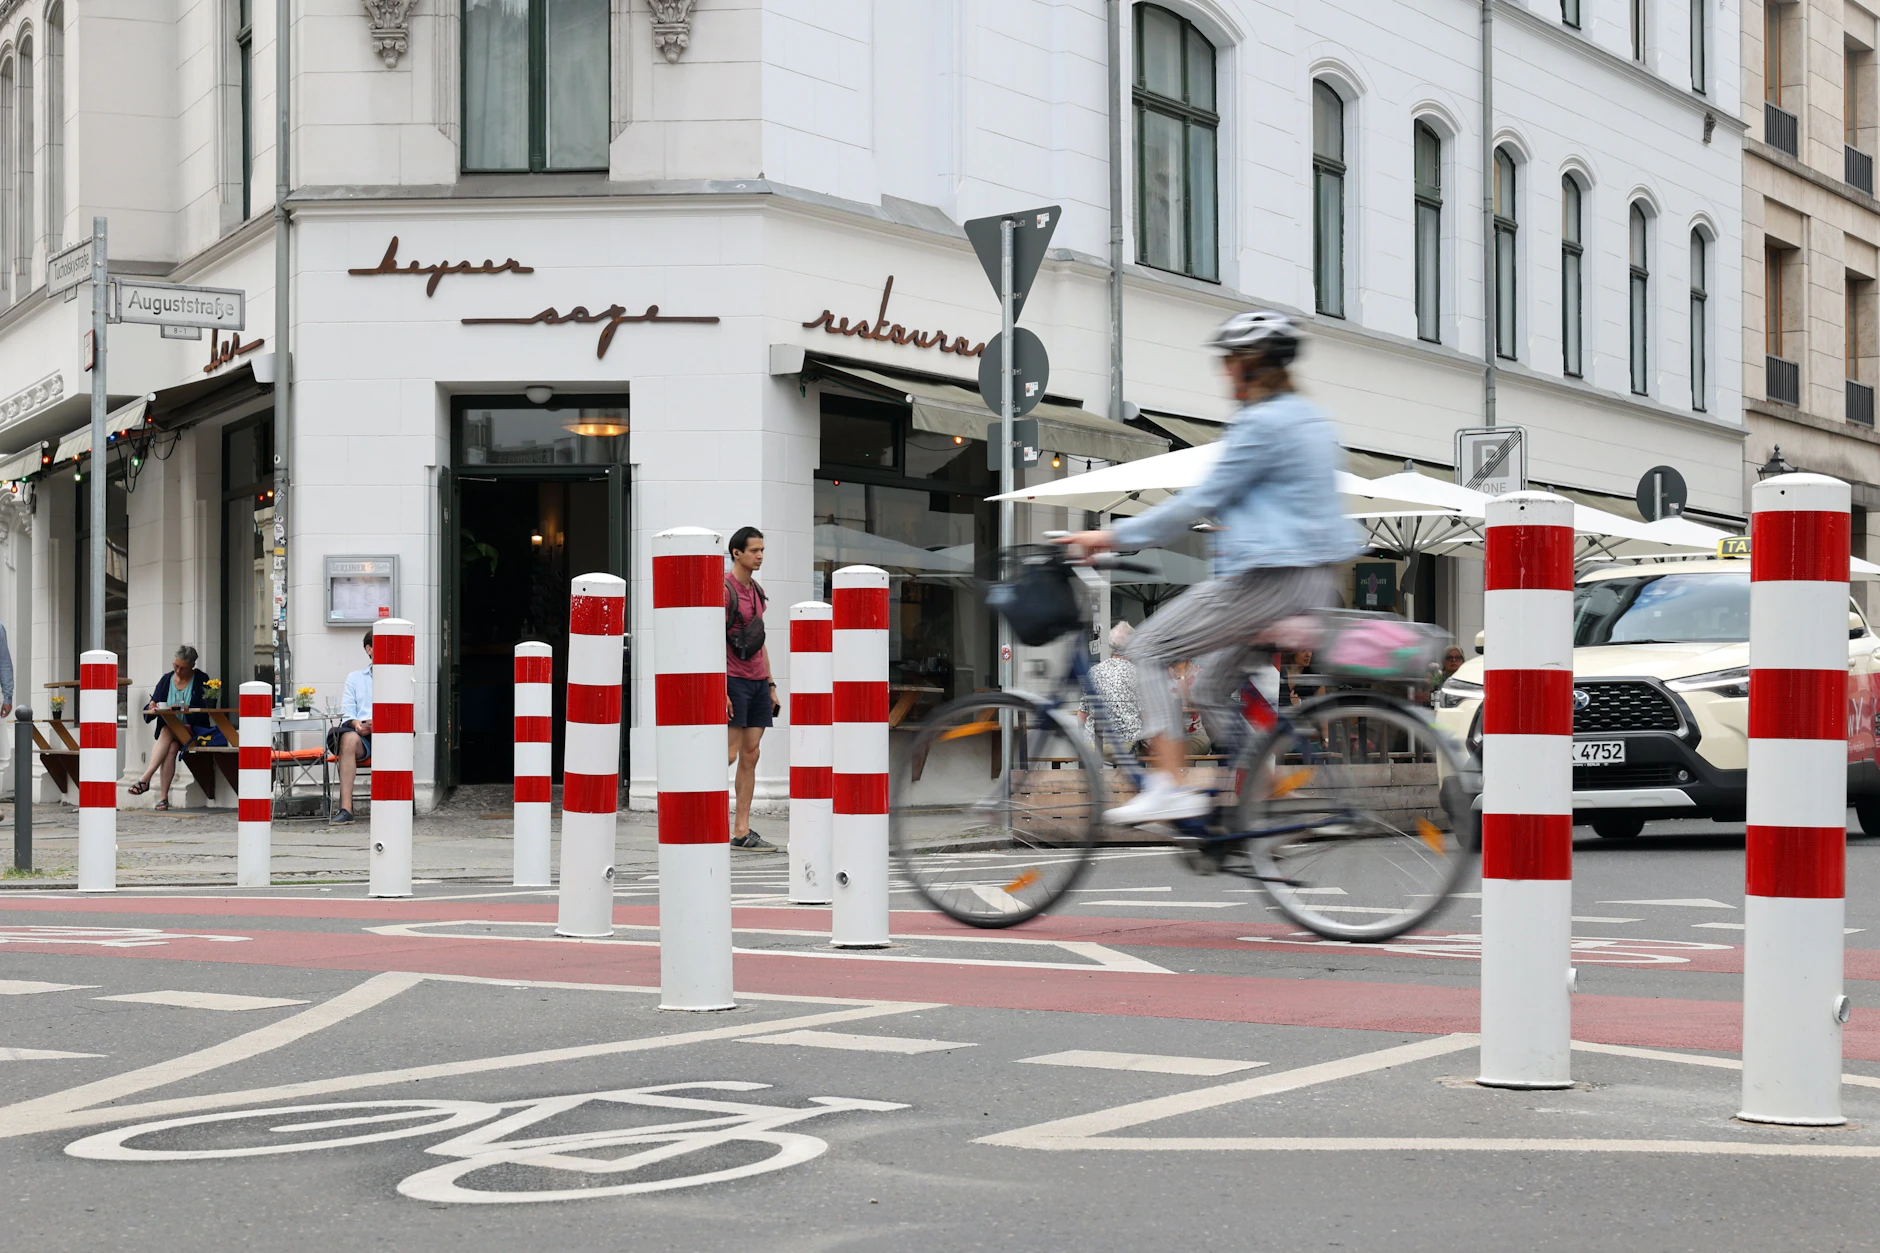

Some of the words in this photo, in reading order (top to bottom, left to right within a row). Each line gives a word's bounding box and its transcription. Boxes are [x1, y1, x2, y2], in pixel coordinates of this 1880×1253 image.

[54, 248, 90, 281] Tucholskystraße
[347, 235, 535, 298] keyser
[128, 290, 235, 320] Auguststraße
[1727, 541, 1751, 553] TA
[1581, 743, 1622, 760] 4752
